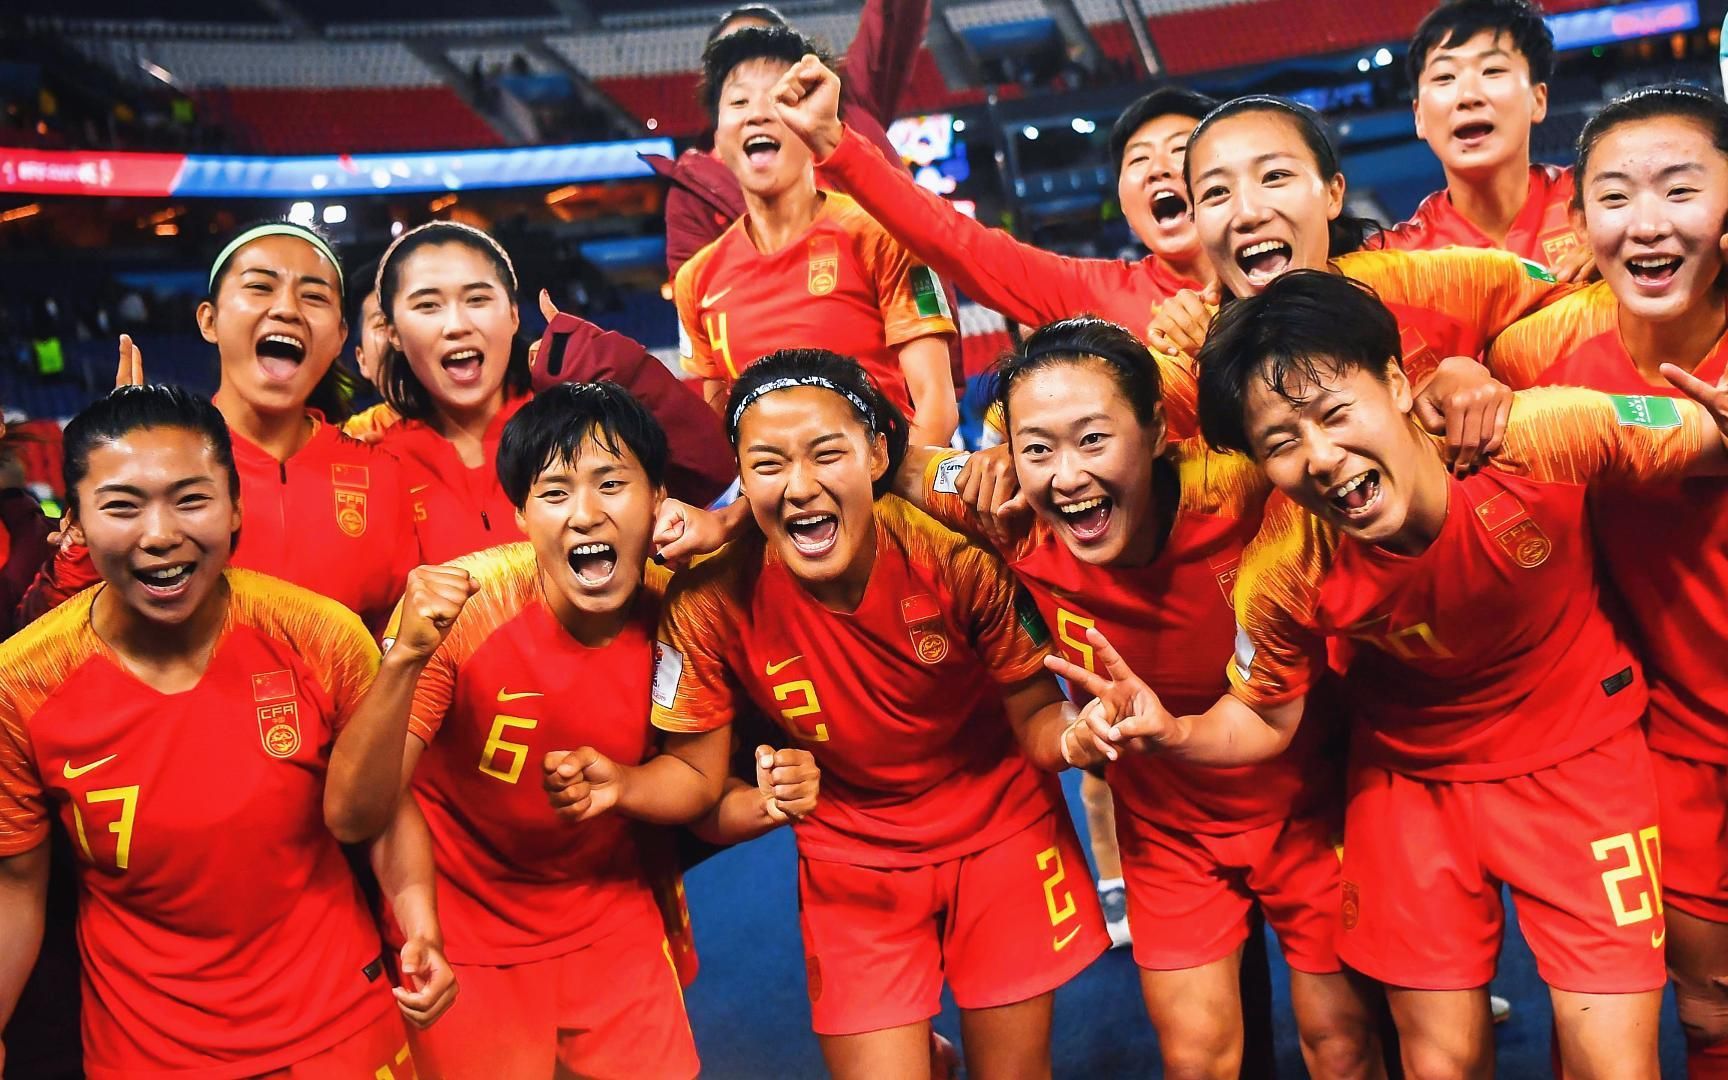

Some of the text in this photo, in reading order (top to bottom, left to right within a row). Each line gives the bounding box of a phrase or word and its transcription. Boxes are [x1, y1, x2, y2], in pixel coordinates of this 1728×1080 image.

[706, 312, 738, 380] 4
[1057, 607, 1095, 673] 5
[260, 704, 294, 720] CFA
[773, 679, 830, 742] 2
[478, 714, 538, 785] 6
[73, 785, 140, 869] 17
[1036, 845, 1077, 927] 2
[1591, 825, 1664, 927] 20
